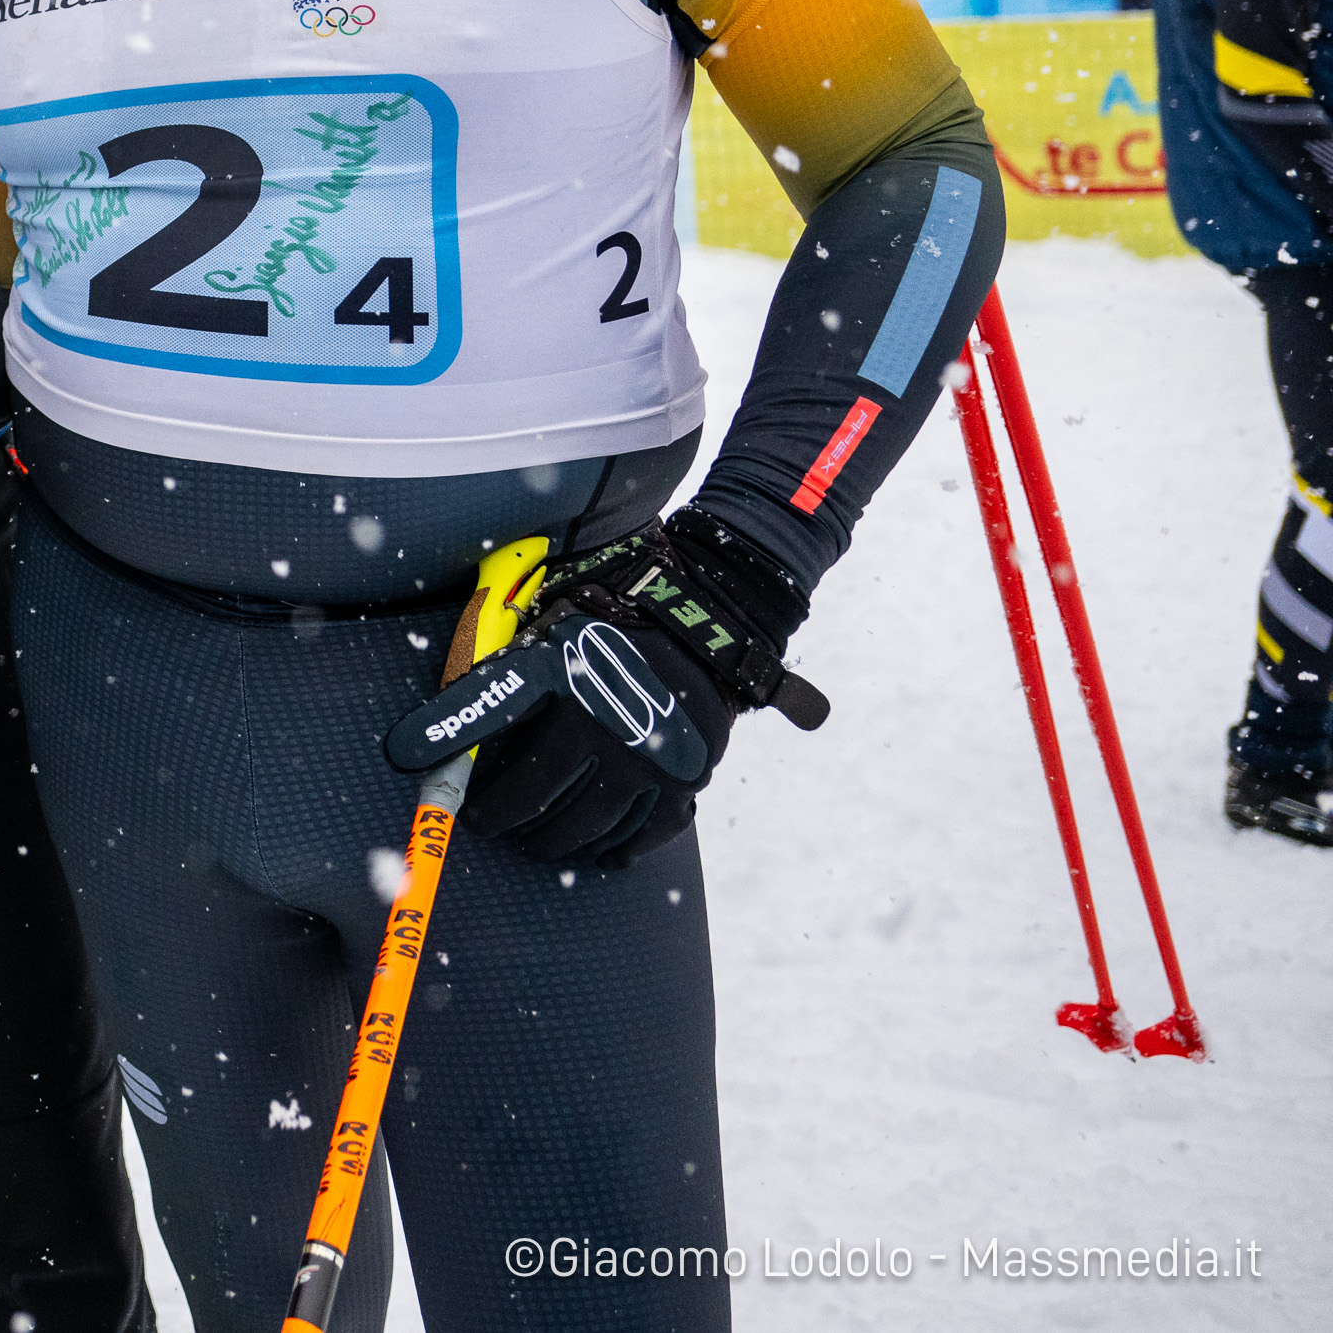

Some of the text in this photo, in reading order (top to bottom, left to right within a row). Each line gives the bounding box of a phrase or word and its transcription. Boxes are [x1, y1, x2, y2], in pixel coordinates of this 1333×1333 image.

[87, 123, 269, 338] 2
[333, 257, 430, 345] 4
[596, 230, 651, 324] 2
[425, 669, 526, 744] sportful
[420, 810, 451, 859] RCS
[393, 909, 424, 960] RCS
